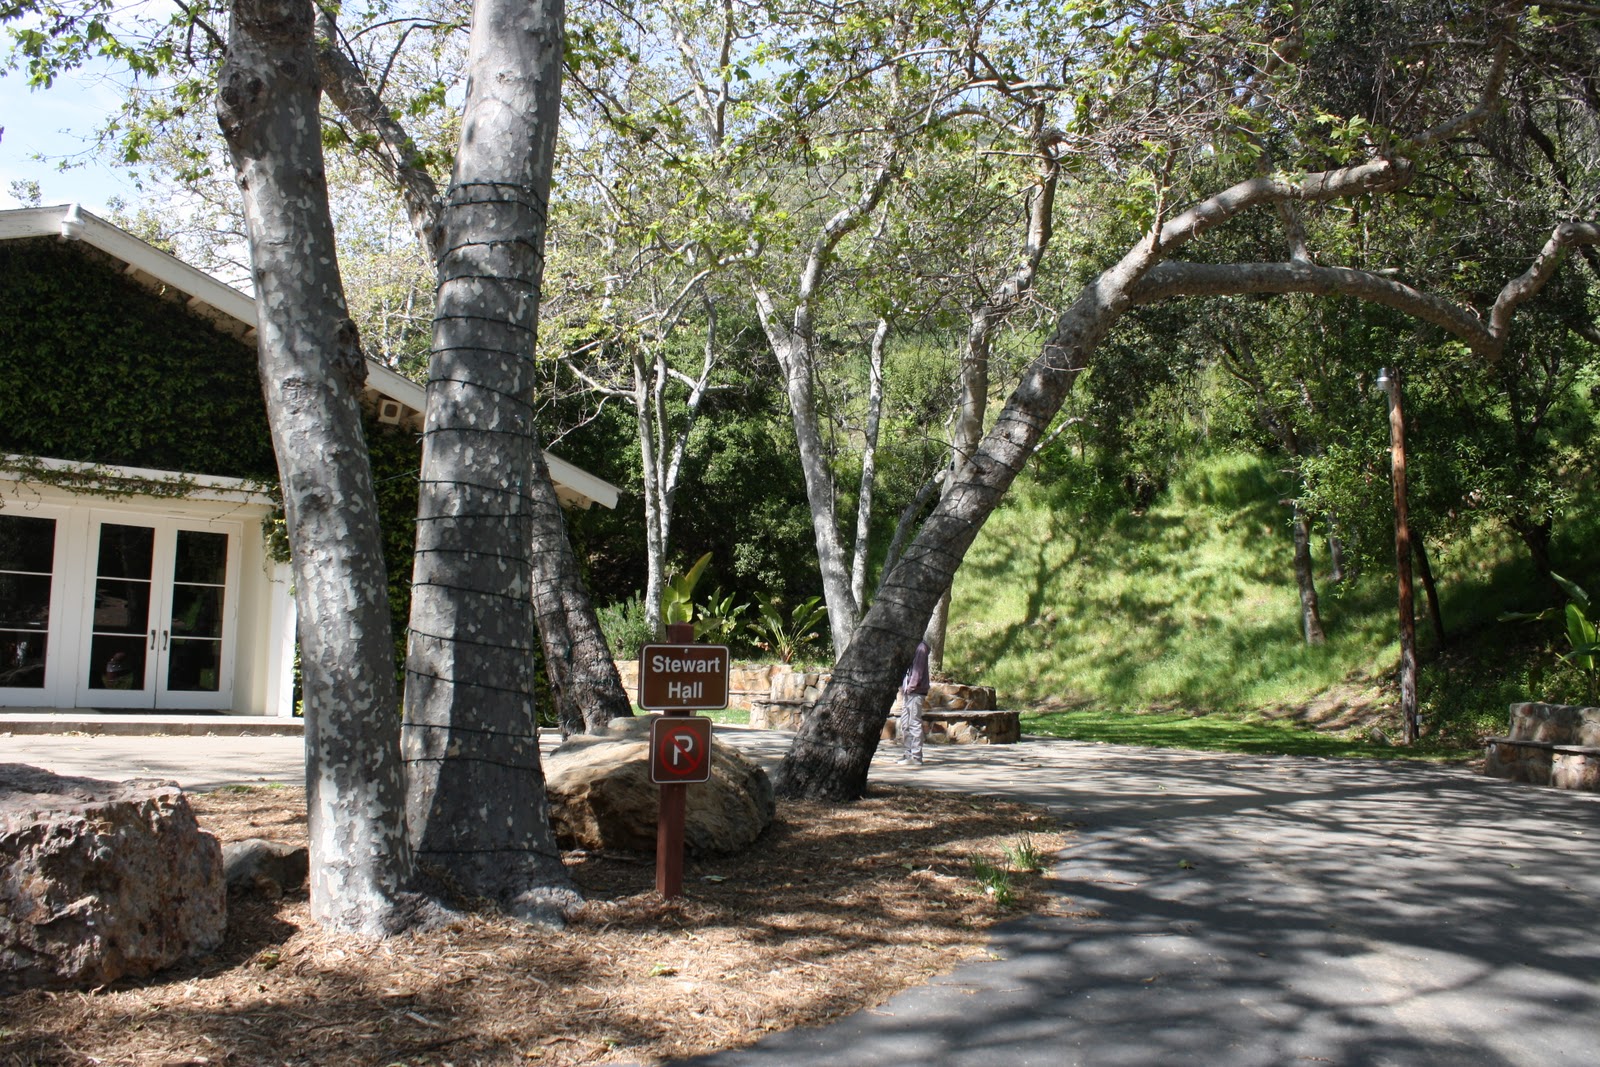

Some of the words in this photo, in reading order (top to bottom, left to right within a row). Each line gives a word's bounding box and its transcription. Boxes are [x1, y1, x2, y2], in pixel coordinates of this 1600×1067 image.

[652, 655, 720, 673] Stewart
[668, 681, 703, 699] Hall
[673, 735, 693, 765] P
